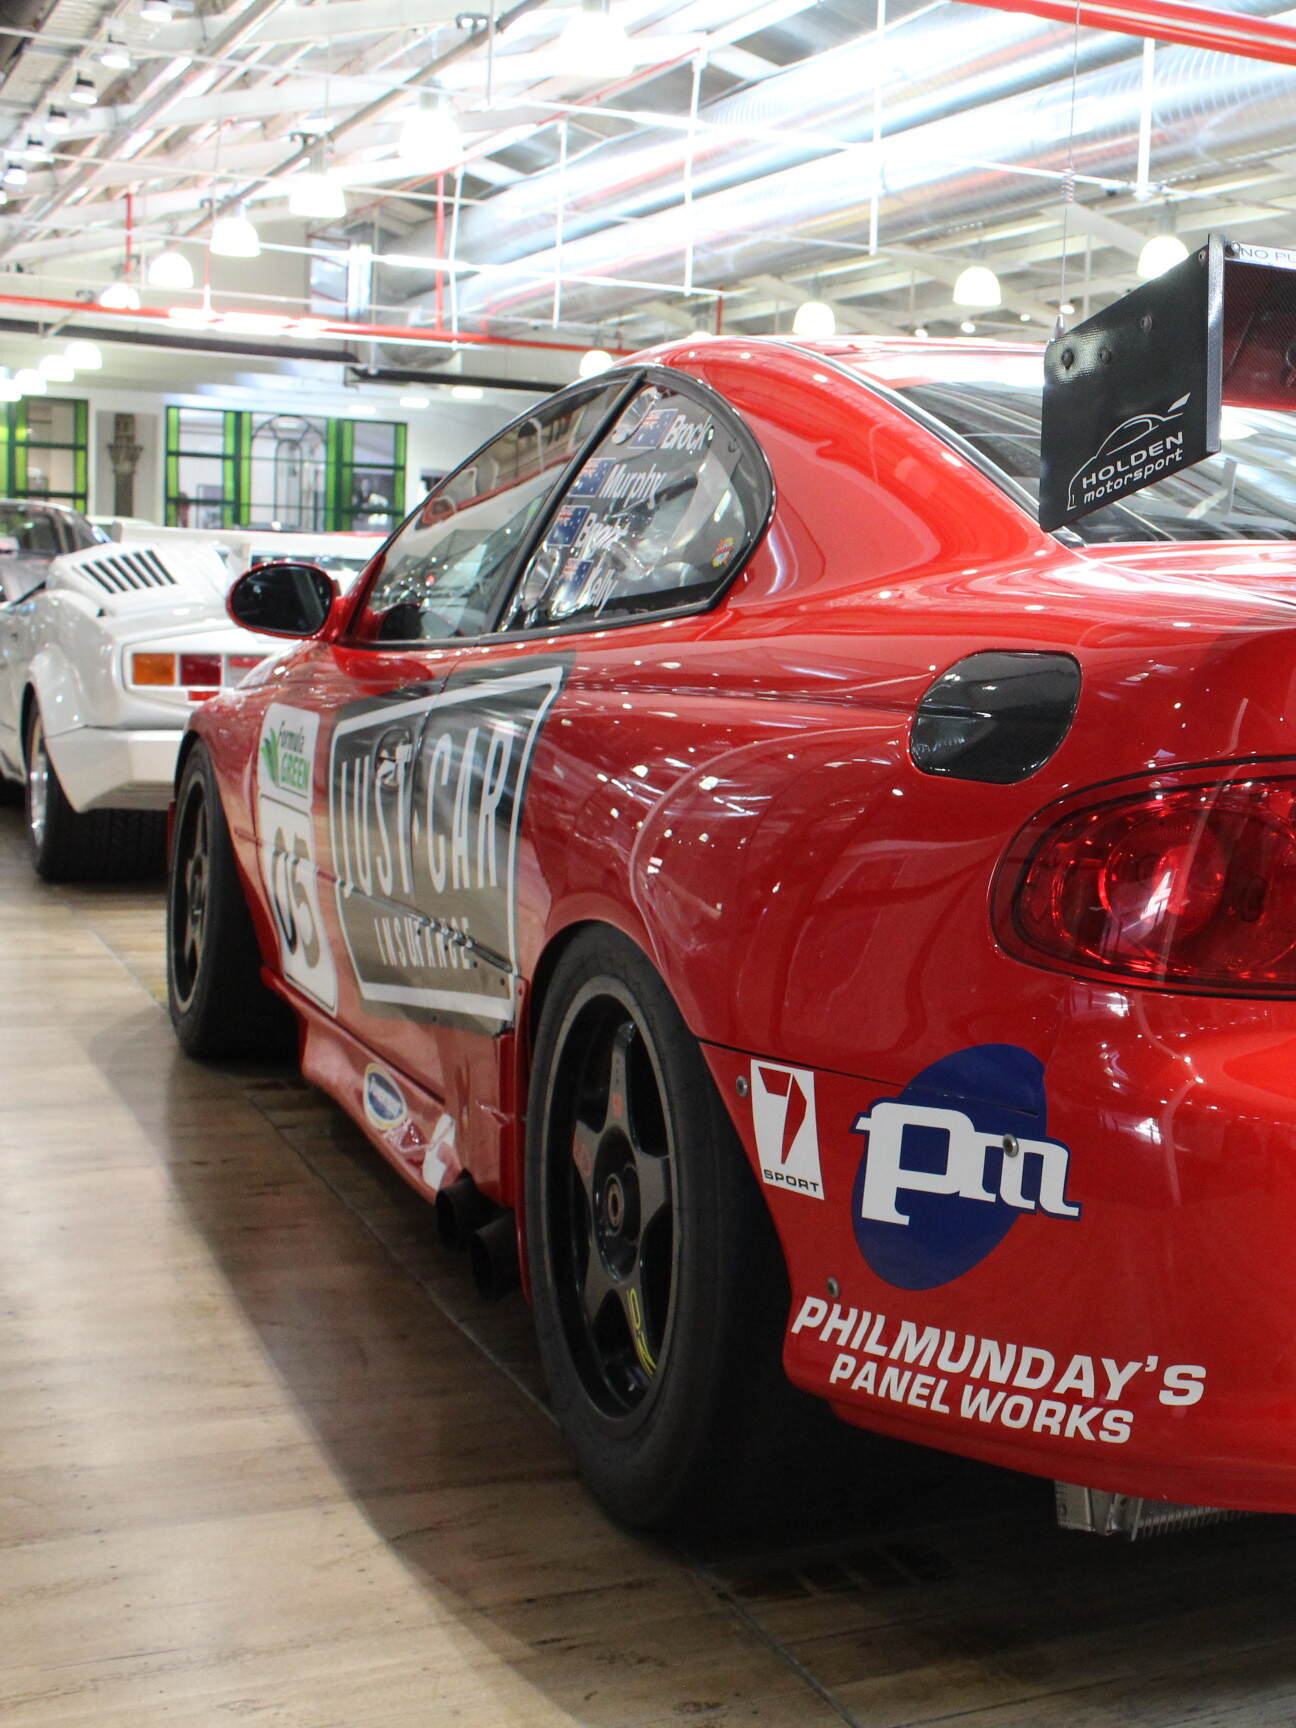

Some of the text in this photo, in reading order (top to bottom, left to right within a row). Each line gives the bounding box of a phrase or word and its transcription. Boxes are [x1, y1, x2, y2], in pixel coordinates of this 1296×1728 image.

[1241, 247, 1269, 259] NO
[661, 415, 713, 451] Brock
[1082, 431, 1183, 490] HOLDEN
[1084, 447, 1183, 504] motorsport
[599, 464, 667, 511] Murphy
[279, 720, 305, 754] Formula
[281, 753, 310, 791] GREEN
[341, 721, 514, 898] JUST CAR
[273, 826, 320, 968] 05
[763, 1168, 820, 1193] SPORT
[829, 1354, 1134, 1444] PANEL WORKS
